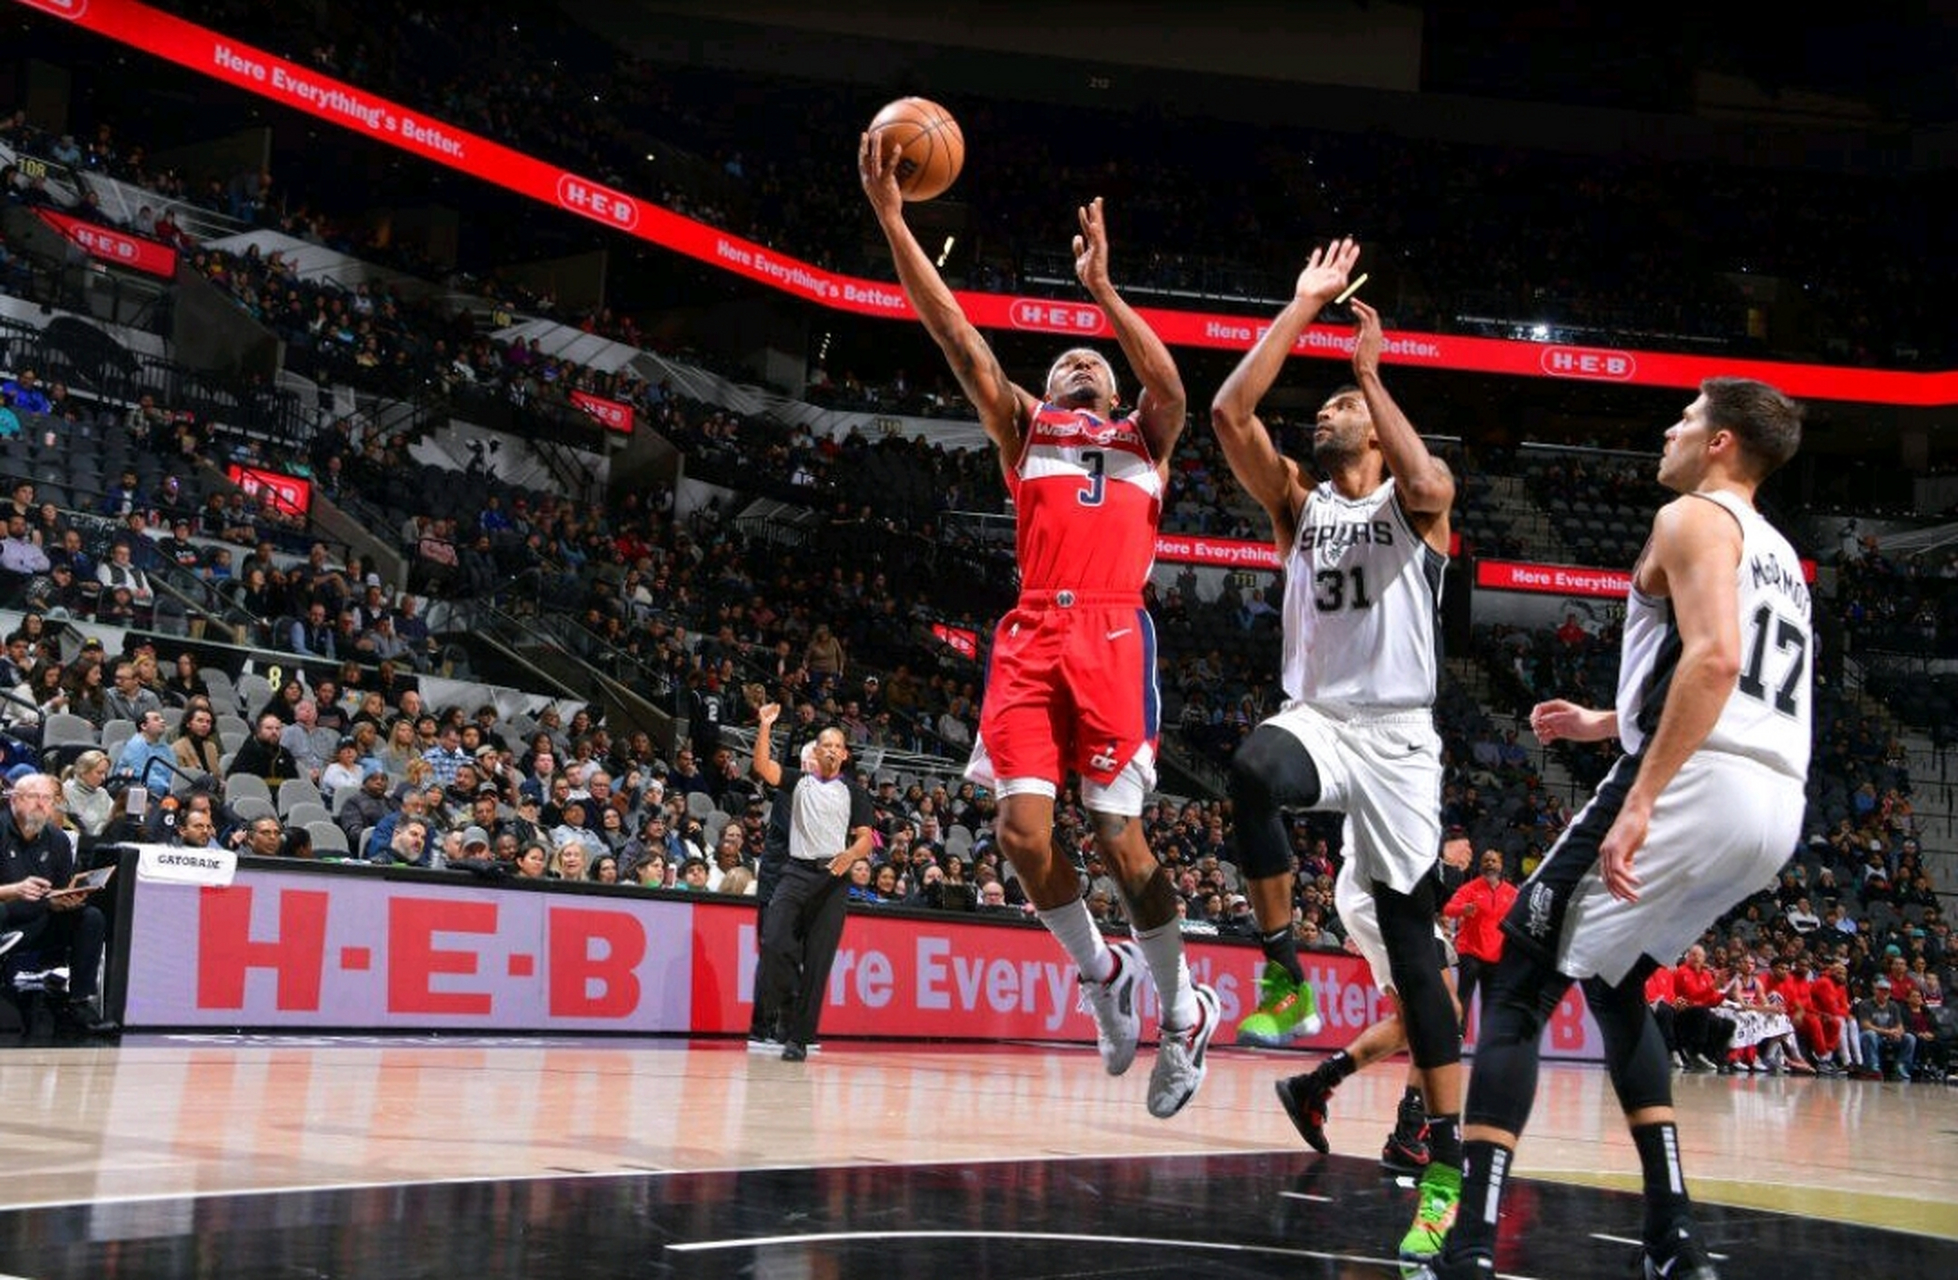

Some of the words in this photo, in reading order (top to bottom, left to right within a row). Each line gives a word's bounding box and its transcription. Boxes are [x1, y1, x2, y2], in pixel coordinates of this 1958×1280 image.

[214, 44, 266, 81] Here
[271, 66, 398, 131] Everything's
[402, 117, 466, 159] Better.
[717, 239, 753, 265] Here
[755, 253, 840, 298] Everything's
[843, 284, 906, 309] Better.
[1206, 322, 1251, 341] Here
[1078, 450, 1106, 507] 3
[1194, 543, 1283, 566] Everything
[1314, 565, 1371, 613] 31
[1511, 568, 1550, 586] Here
[1555, 572, 1631, 592] Everythin
[1738, 602, 1807, 719] 17
[268, 664, 282, 692] 8
[708, 703, 719, 722] 2
[157, 854, 221, 869] GATORADE
